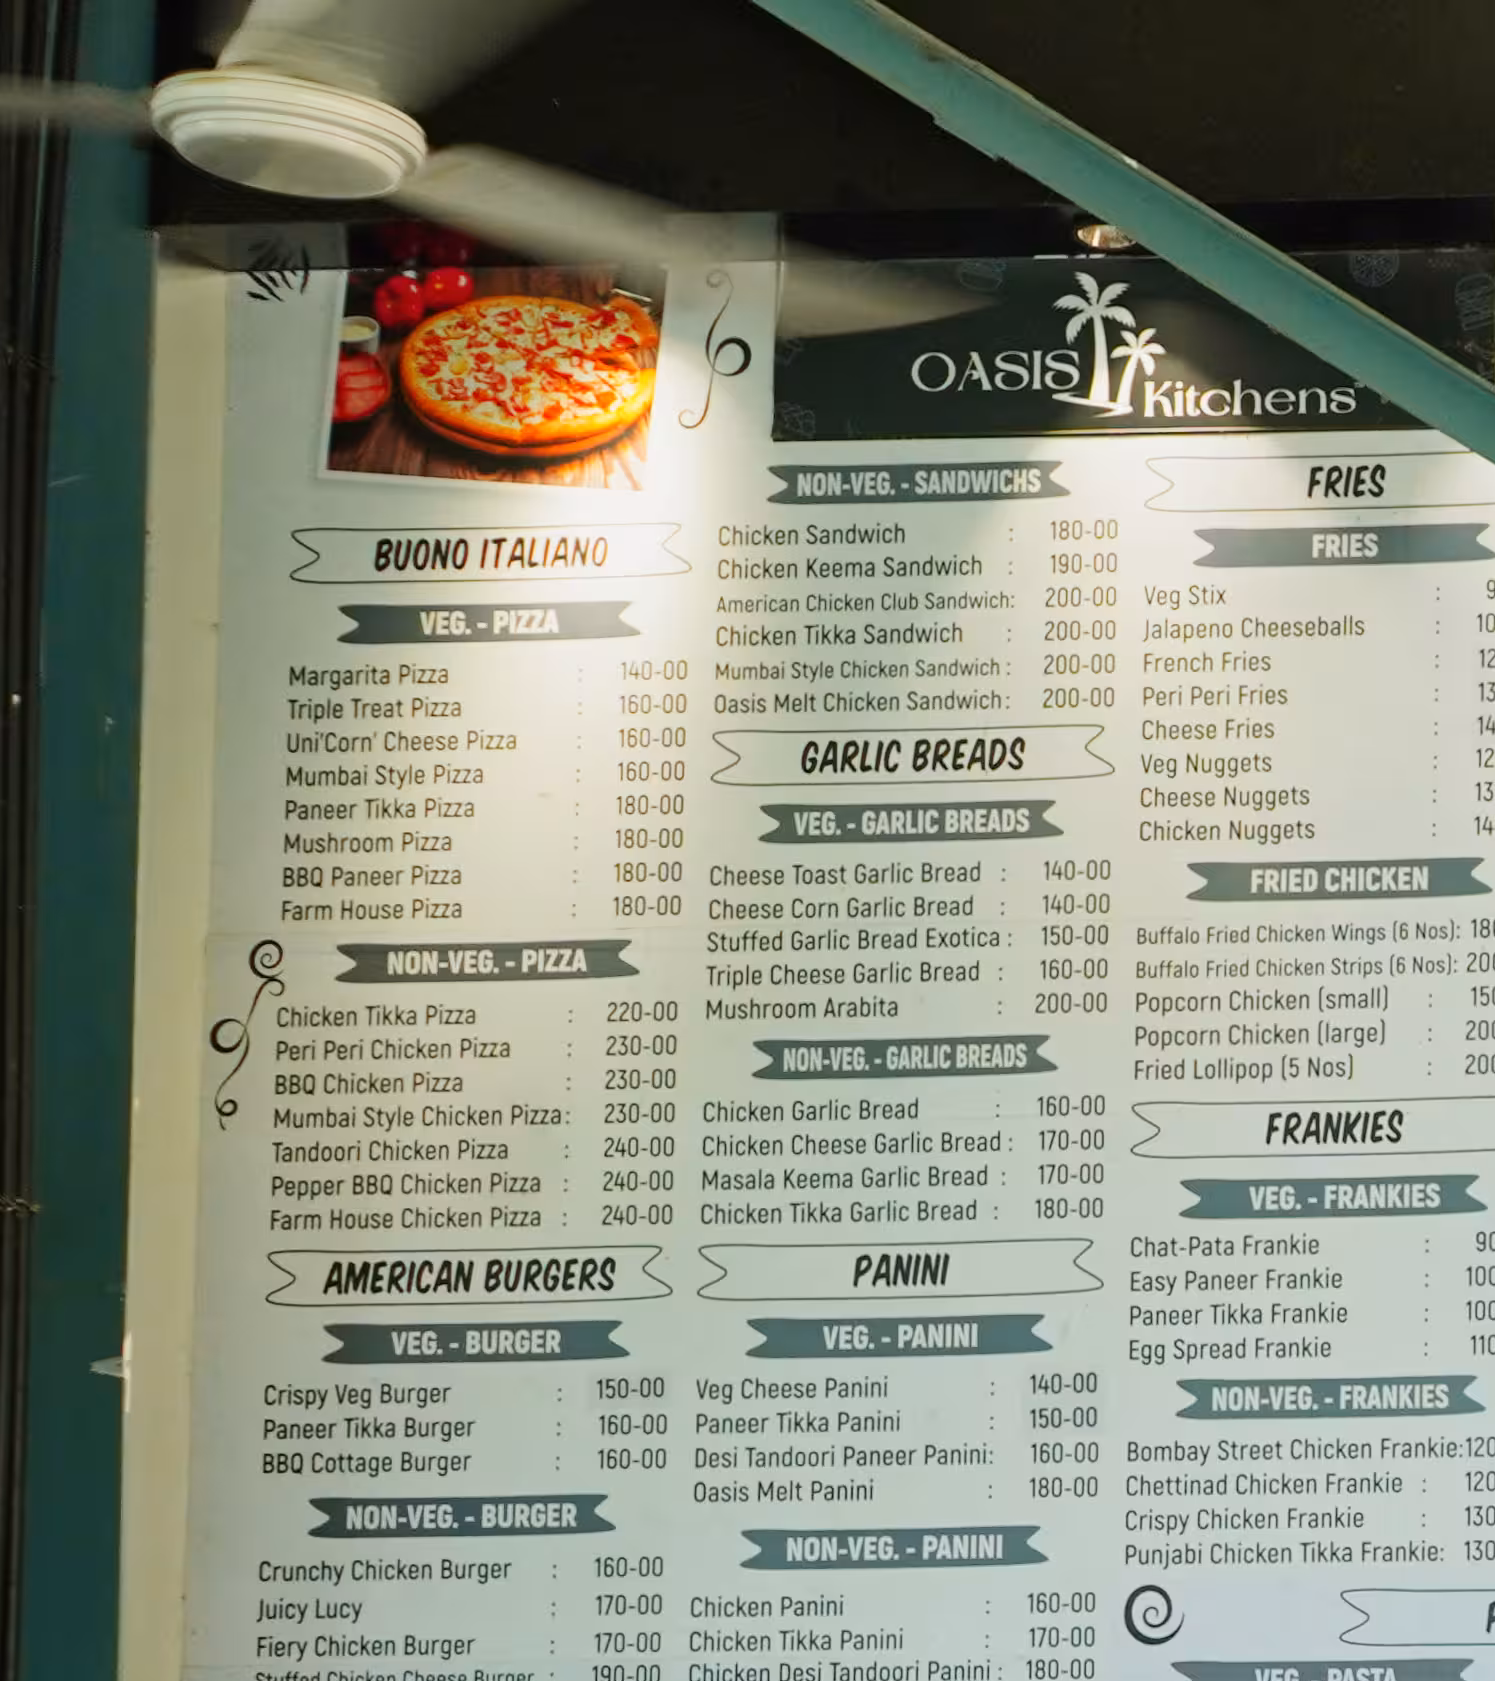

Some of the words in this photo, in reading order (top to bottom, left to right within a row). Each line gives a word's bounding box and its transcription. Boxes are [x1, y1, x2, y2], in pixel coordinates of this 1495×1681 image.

[911, 349, 1081, 393] OASIS
[797, 471, 896, 497] NON-VEG.
[914, 469, 1042, 495] SANDWICHS
[1307, 463, 1387, 498] FRIES
[721, 524, 799, 546] Chicken
[805, 522, 906, 545] Sandwich
[1050, 519, 1118, 541] 180-00
[373, 537, 469, 573] BUONO
[480, 537, 608, 569] ITALIANO
[1311, 533, 1379, 559] FRIES
[1144, 585, 1181, 611] Veg
[1188, 584, 1226, 606] Stix
[419, 609, 472, 635] VEG.
[493, 609, 560, 635] PIZZA
[621, 659, 689, 681] 140-00
[1143, 652, 1214, 673] French
[1221, 650, 1272, 672] Fries
[288, 663, 391, 692] Margarita
[399, 663, 448, 684] Pizza
[620, 693, 688, 715] 160-00
[1143, 686, 1183, 707] Peri
[1190, 685, 1230, 707] Peri
[1238, 684, 1289, 706] Fries
[285, 697, 345, 726] Triple
[349, 697, 403, 719] Treat
[411, 697, 461, 718] Pizza
[800, 739, 902, 775] GARLIC
[912, 736, 1026, 773] BREADS
[1250, 867, 1319, 894] FRIED
[1324, 866, 1429, 893] CHICKEN
[387, 949, 500, 975] NON-VEG.
[521, 948, 588, 973] PIZZA
[276, 1005, 358, 1028] Chicken
[365, 1004, 417, 1026] Tikka
[425, 1004, 476, 1025] Pizza
[606, 1000, 678, 1023] 220-00
[705, 998, 816, 1020] Mushroom
[823, 995, 899, 1018] Arabita
[1034, 991, 1108, 1014] 200-00
[1265, 1109, 1404, 1145] FRANKIES
[1249, 1185, 1302, 1211] VEG.
[1324, 1182, 1441, 1210] FRANKIES
[322, 1259, 475, 1295] AMERICAN
[484, 1256, 616, 1293] BURGERS
[853, 1253, 950, 1288] PANINI
[1129, 1339, 1166, 1366] Egg
[1173, 1337, 1247, 1365] Spread
[1254, 1336, 1332, 1359] Frankie
[263, 1383, 329, 1411] Crispy
[334, 1384, 372, 1410] Veg
[380, 1382, 452, 1409] Burger
[596, 1376, 665, 1400] 150-00
[696, 1379, 733, 1405] Veg
[741, 1377, 817, 1400] Cheese
[825, 1375, 888, 1399] Panini
[1030, 1371, 1098, 1395] 140-00
[1125, 1509, 1190, 1536] Crispy
[1197, 1508, 1279, 1530] Chicken
[1287, 1507, 1364, 1529] Frankie
[256, 1597, 309, 1625] Juicy
[315, 1598, 363, 1624] Lucy
[595, 1593, 663, 1616] 170-00
